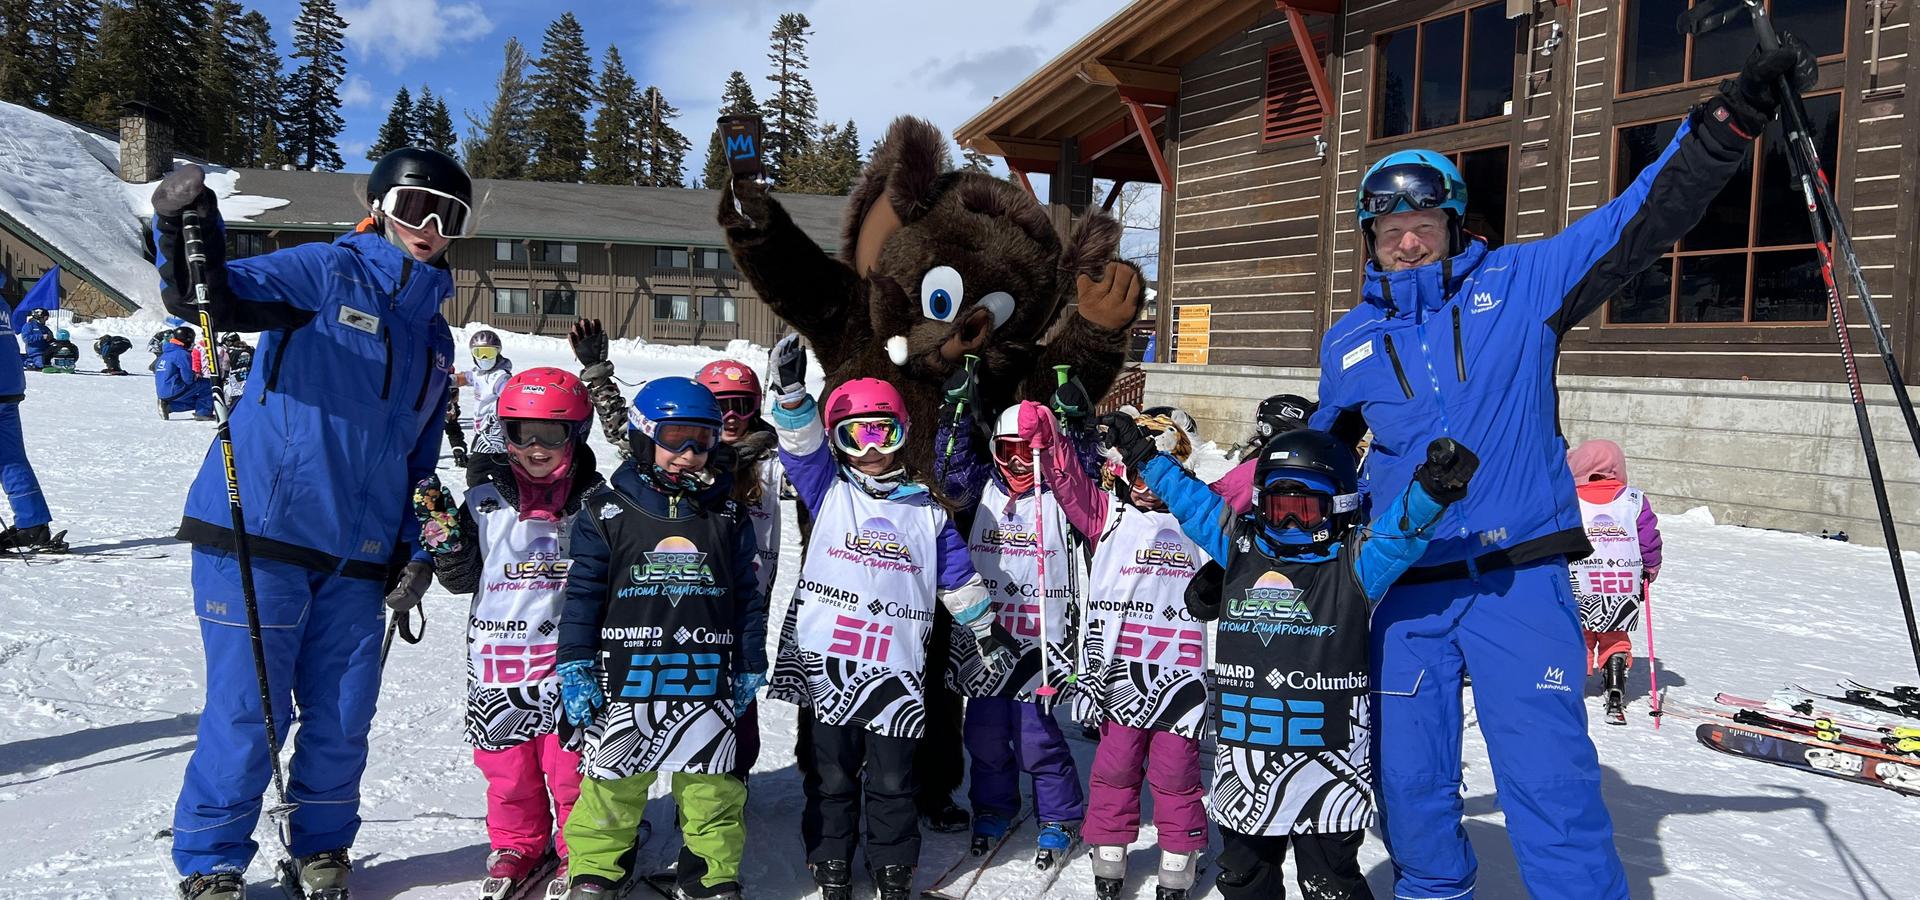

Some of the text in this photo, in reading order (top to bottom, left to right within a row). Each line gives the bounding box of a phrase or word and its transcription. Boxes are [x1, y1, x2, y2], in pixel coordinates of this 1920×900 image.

[223, 441, 242, 508] SCOTT
[863, 529, 897, 542] 2020
[845, 532, 913, 563] USASA
[1154, 541, 1183, 552] 2020
[657, 553, 697, 564] 2020
[826, 546, 926, 576] NATIONAL CHAMPIONSHIPS
[1136, 549, 1196, 571] USASA
[503, 561, 569, 580] USAS
[630, 563, 716, 585] USASA
[1119, 564, 1155, 577] NATIONAL
[798, 578, 860, 606] OODWARD
[1252, 588, 1291, 599] 2020
[817, 595, 842, 609] COPPER
[848, 604, 858, 613] CO
[1227, 598, 1314, 623] USASA
[601, 626, 664, 640] OODWARD
[1219, 620, 1337, 637] ATIONAL CHAMPIONSHIPS
[1215, 663, 1255, 680] DWARD
[1286, 670, 1369, 691] Columbia
[1245, 680, 1255, 688] CO
